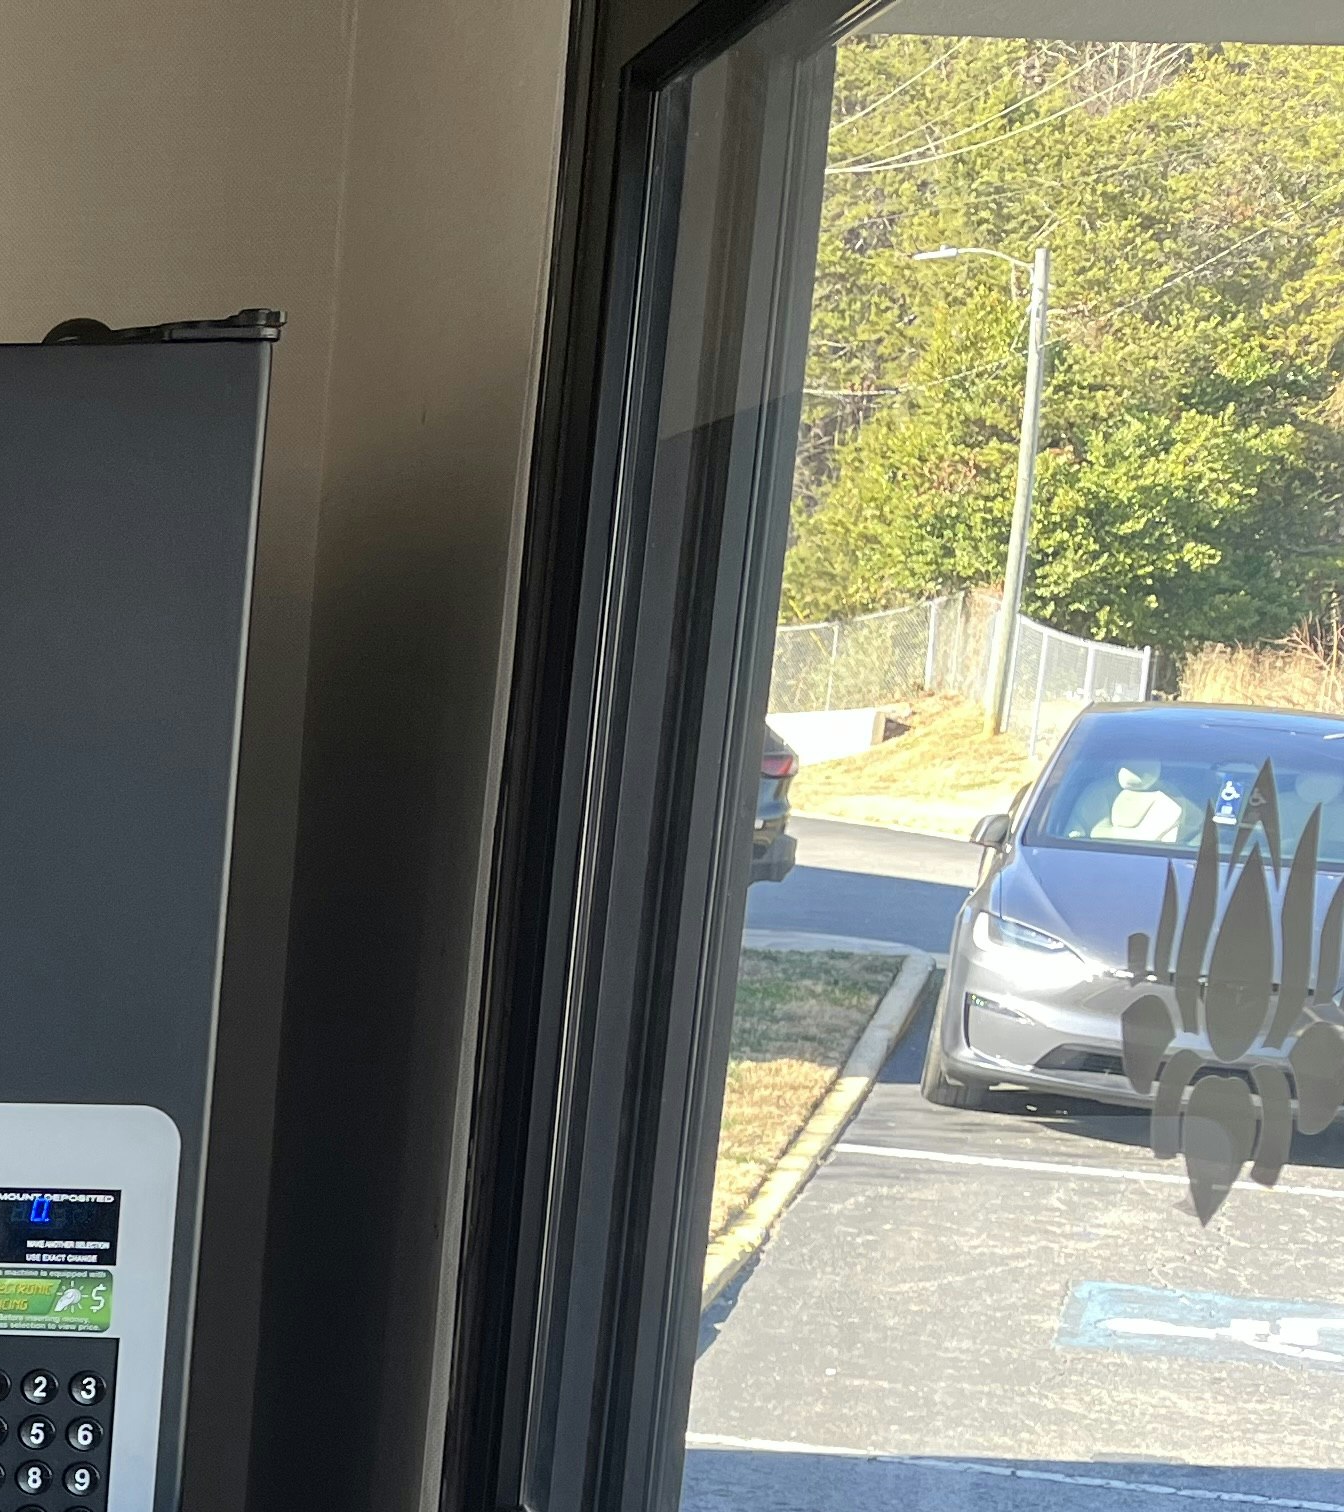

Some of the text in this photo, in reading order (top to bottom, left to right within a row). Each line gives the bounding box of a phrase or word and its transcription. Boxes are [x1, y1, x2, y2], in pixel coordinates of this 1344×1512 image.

[44, 1194, 114, 1202] DEPOSITED
[42, 1254, 66, 1262] EXACT
[67, 1254, 98, 1262] CHANGE
[33, 1376, 47, 1397] 2
[81, 1377, 96, 1399] 3
[30, 1423, 45, 1445] 5
[77, 1424, 93, 1445] 6
[27, 1467, 42, 1489] 8
[74, 1468, 90, 1490] 9
